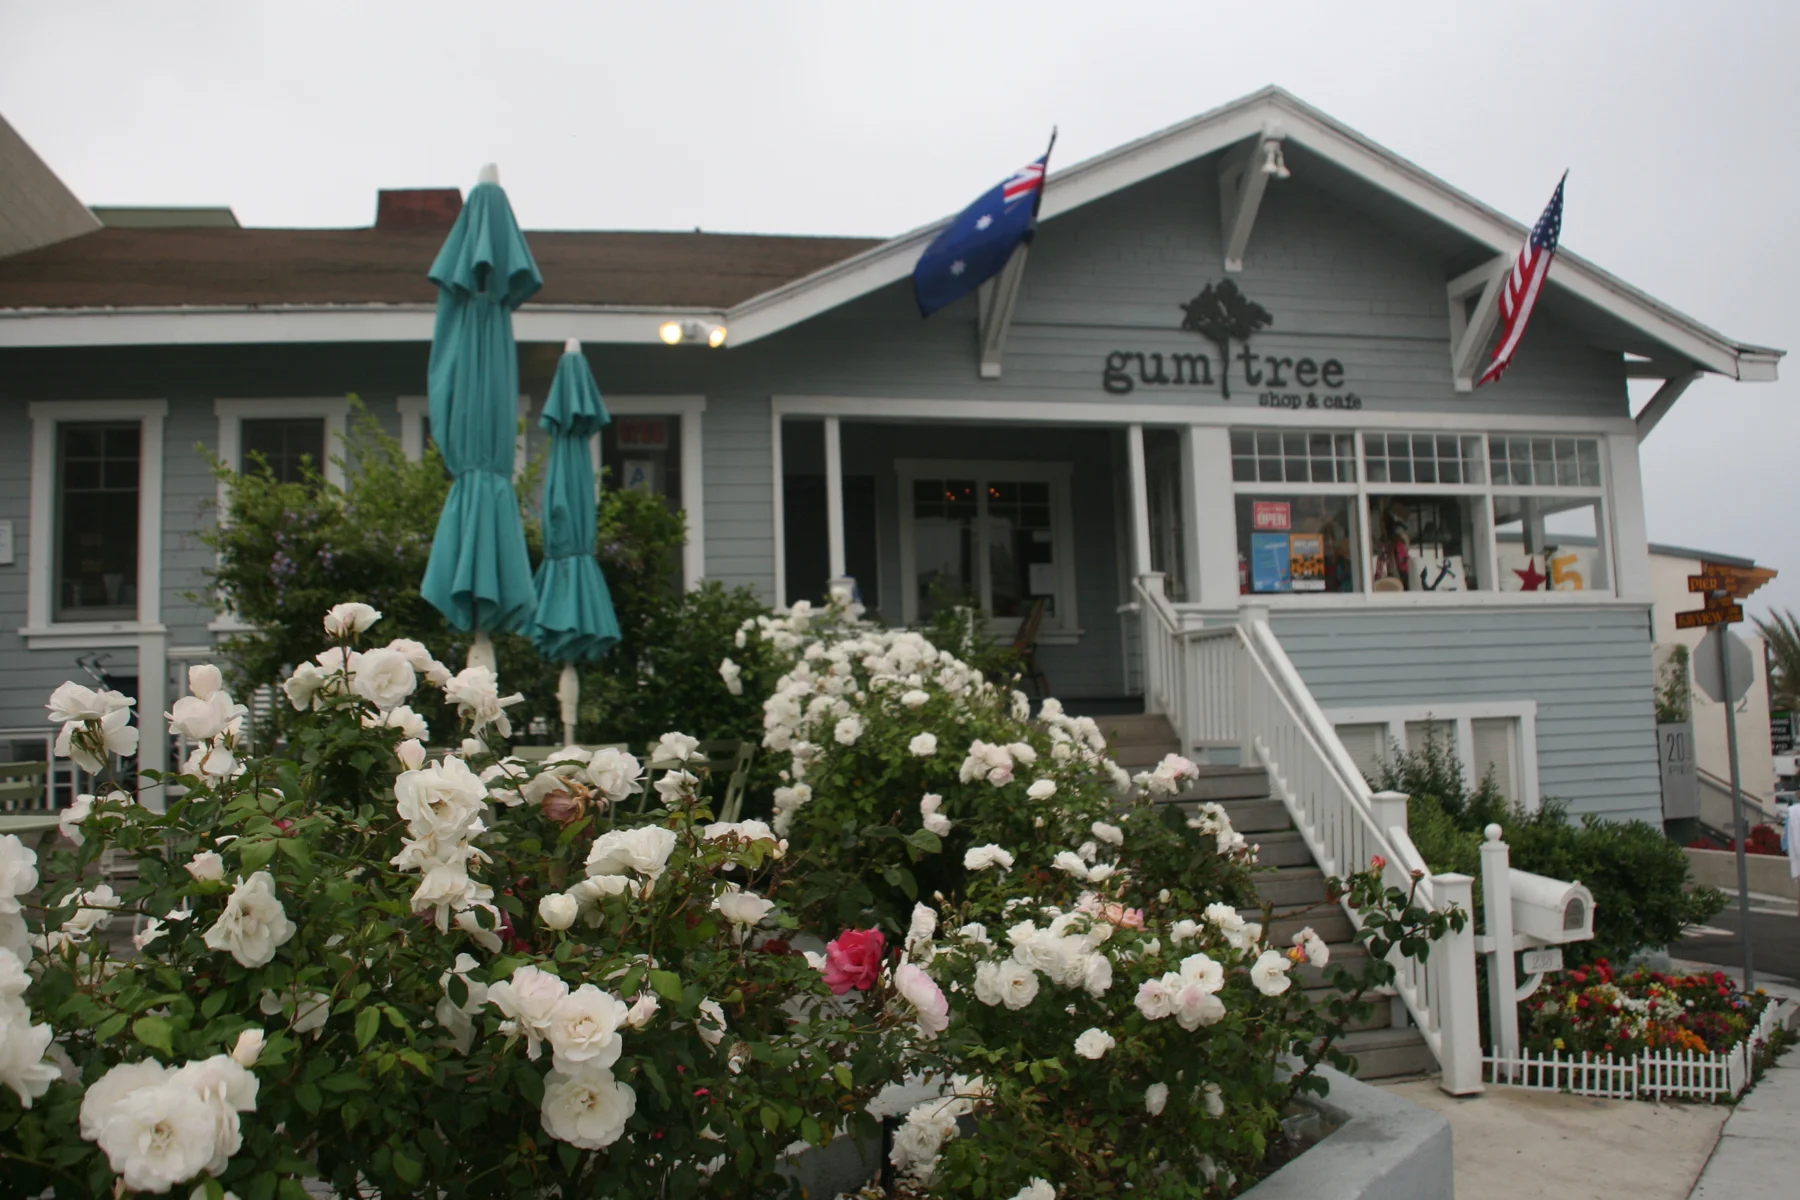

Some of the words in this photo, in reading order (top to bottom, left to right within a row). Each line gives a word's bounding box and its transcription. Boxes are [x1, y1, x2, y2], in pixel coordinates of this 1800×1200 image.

[1103, 350, 1214, 395] gum
[1236, 344, 1345, 388] tree
[1259, 391, 1302, 409] shop
[1306, 392, 1319, 408] &
[1323, 393, 1362, 410] cafe
[1257, 512, 1287, 526] OPEN
[1553, 555, 1583, 591] 5
[1690, 577, 1717, 591] PIER
